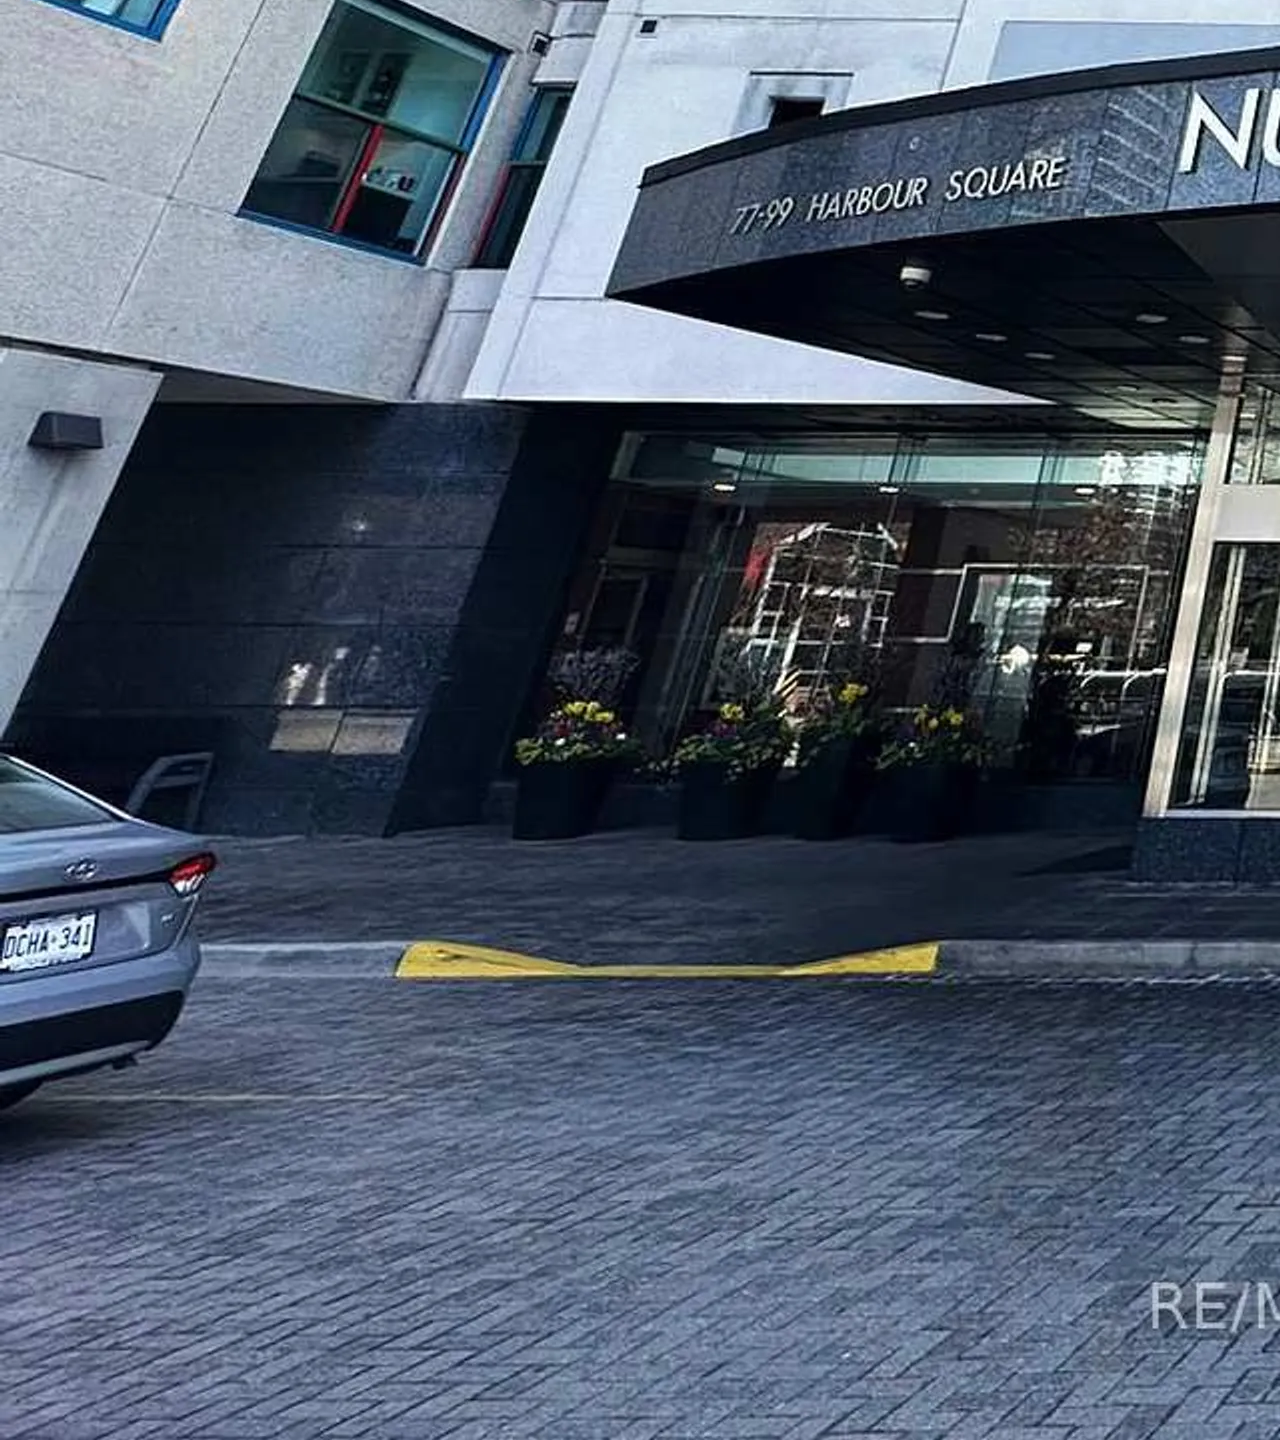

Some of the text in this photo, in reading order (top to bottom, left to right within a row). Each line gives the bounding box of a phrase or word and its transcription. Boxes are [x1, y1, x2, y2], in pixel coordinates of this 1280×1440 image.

[729, 157, 1066, 235] 77-99 HARBOUR SQUARE
